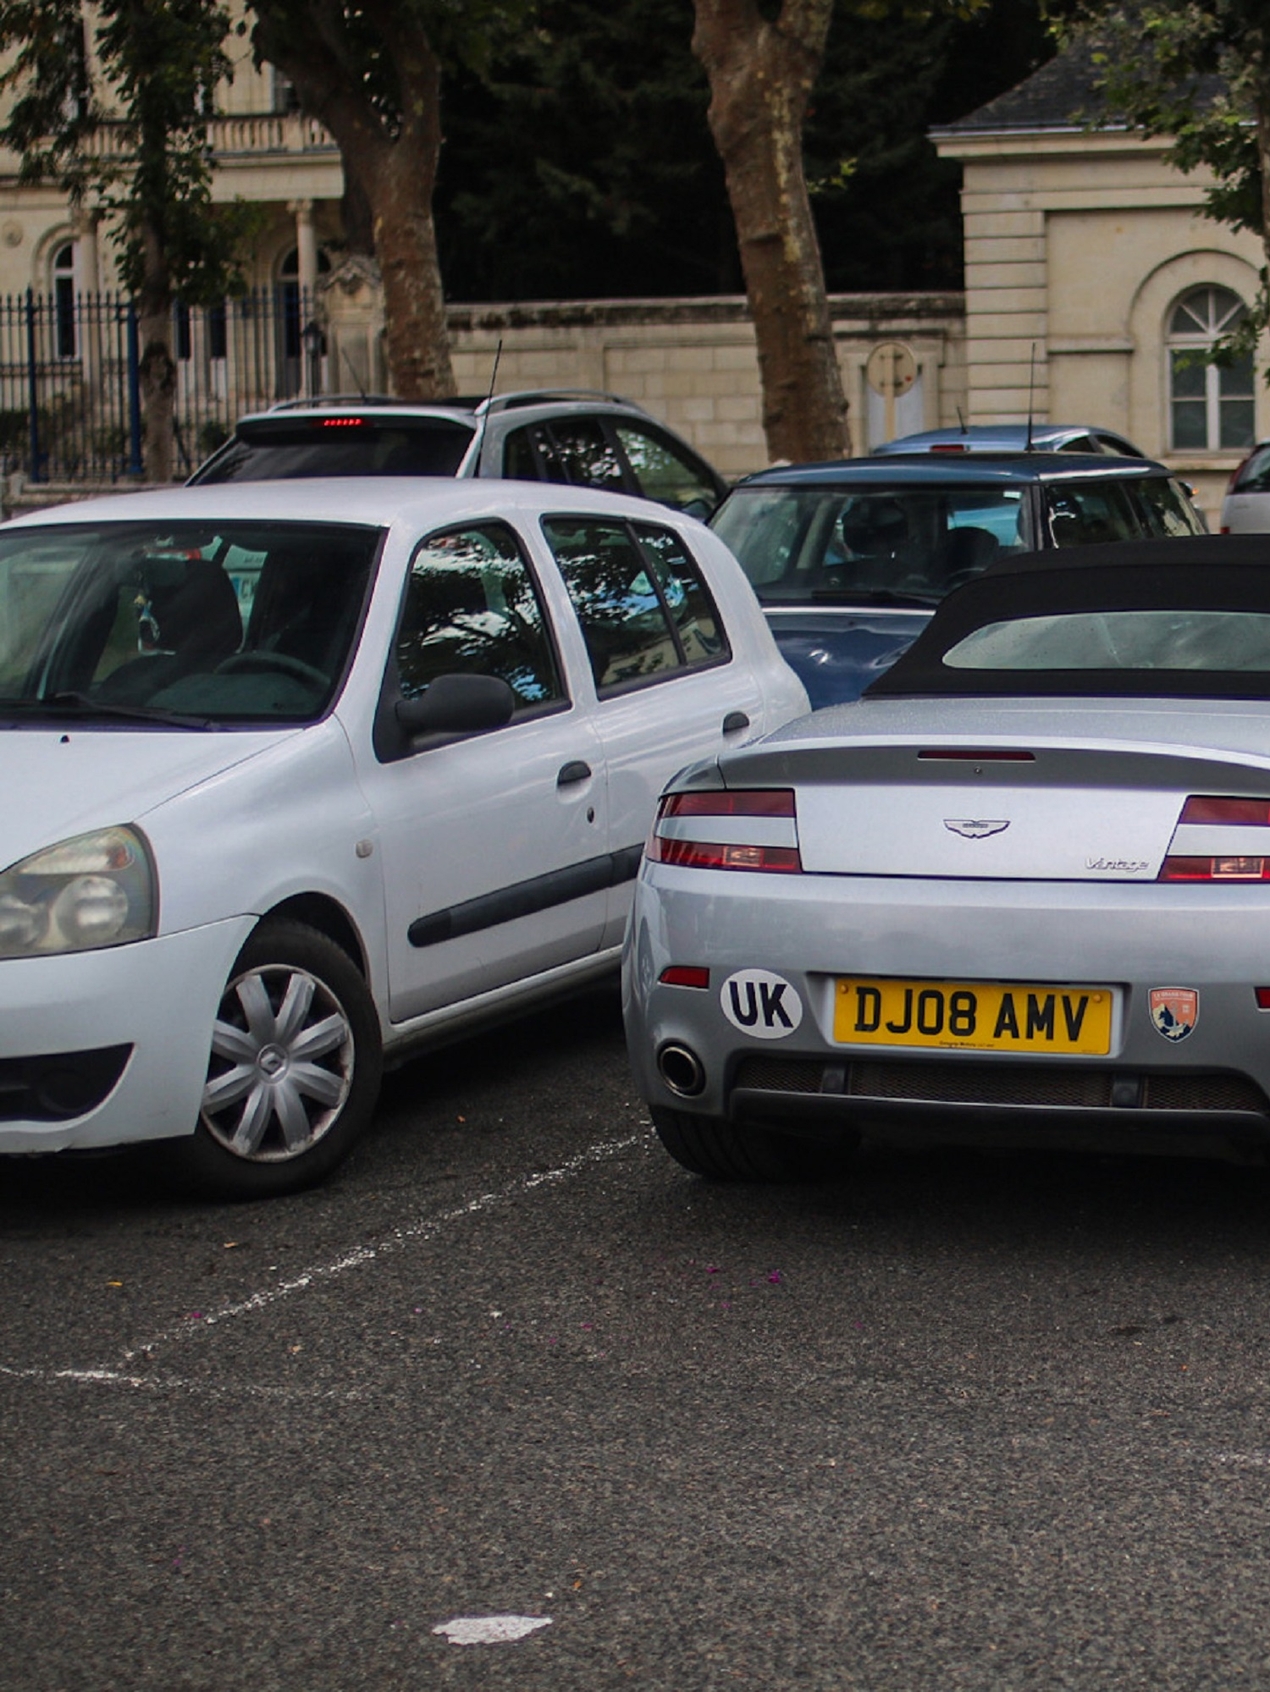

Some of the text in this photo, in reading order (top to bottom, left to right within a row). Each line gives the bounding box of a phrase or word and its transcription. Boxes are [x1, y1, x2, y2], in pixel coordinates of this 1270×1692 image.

[1085, 857, 1150, 873] Vintage
[728, 981, 794, 1028] UK
[854, 986, 1089, 1042] DJ08 AMV
